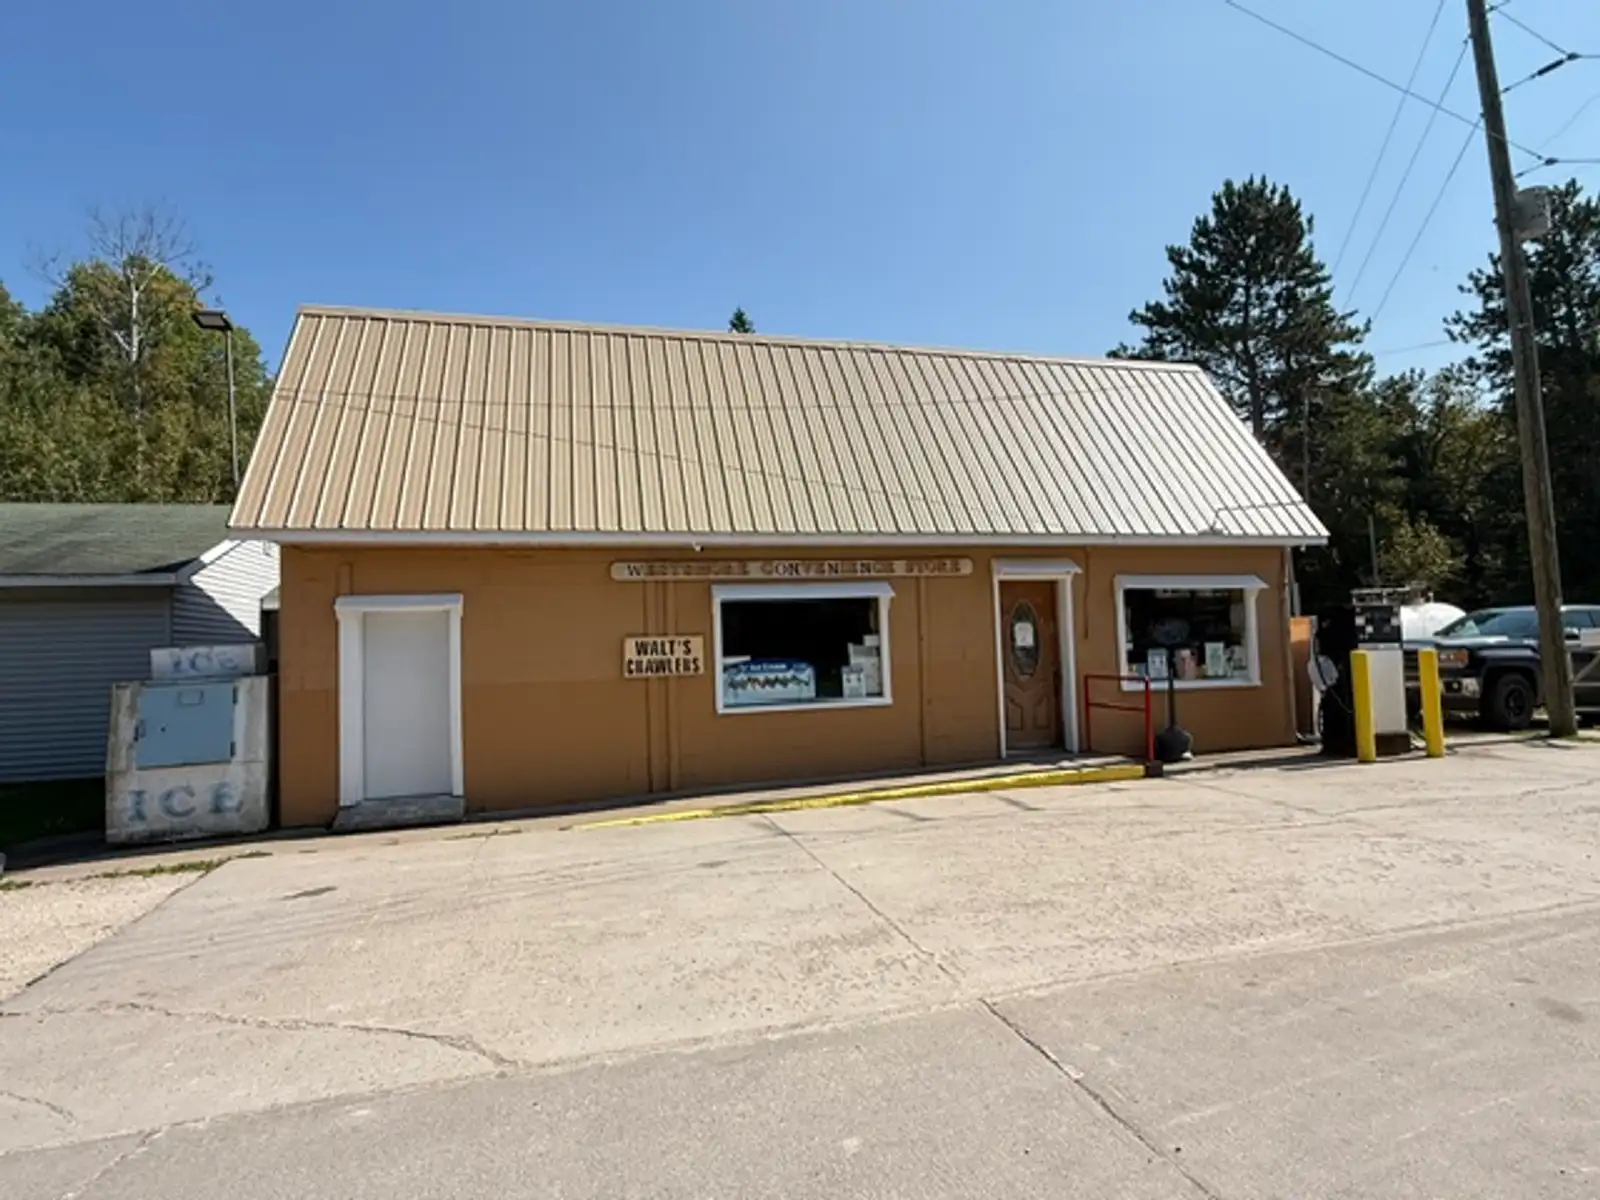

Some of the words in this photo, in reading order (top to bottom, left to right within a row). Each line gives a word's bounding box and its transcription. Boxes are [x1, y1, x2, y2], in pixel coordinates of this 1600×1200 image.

[634, 639, 692, 656] WALT'S
[627, 657, 701, 675] CRAWLERS
[126, 782, 245, 822] ICE
